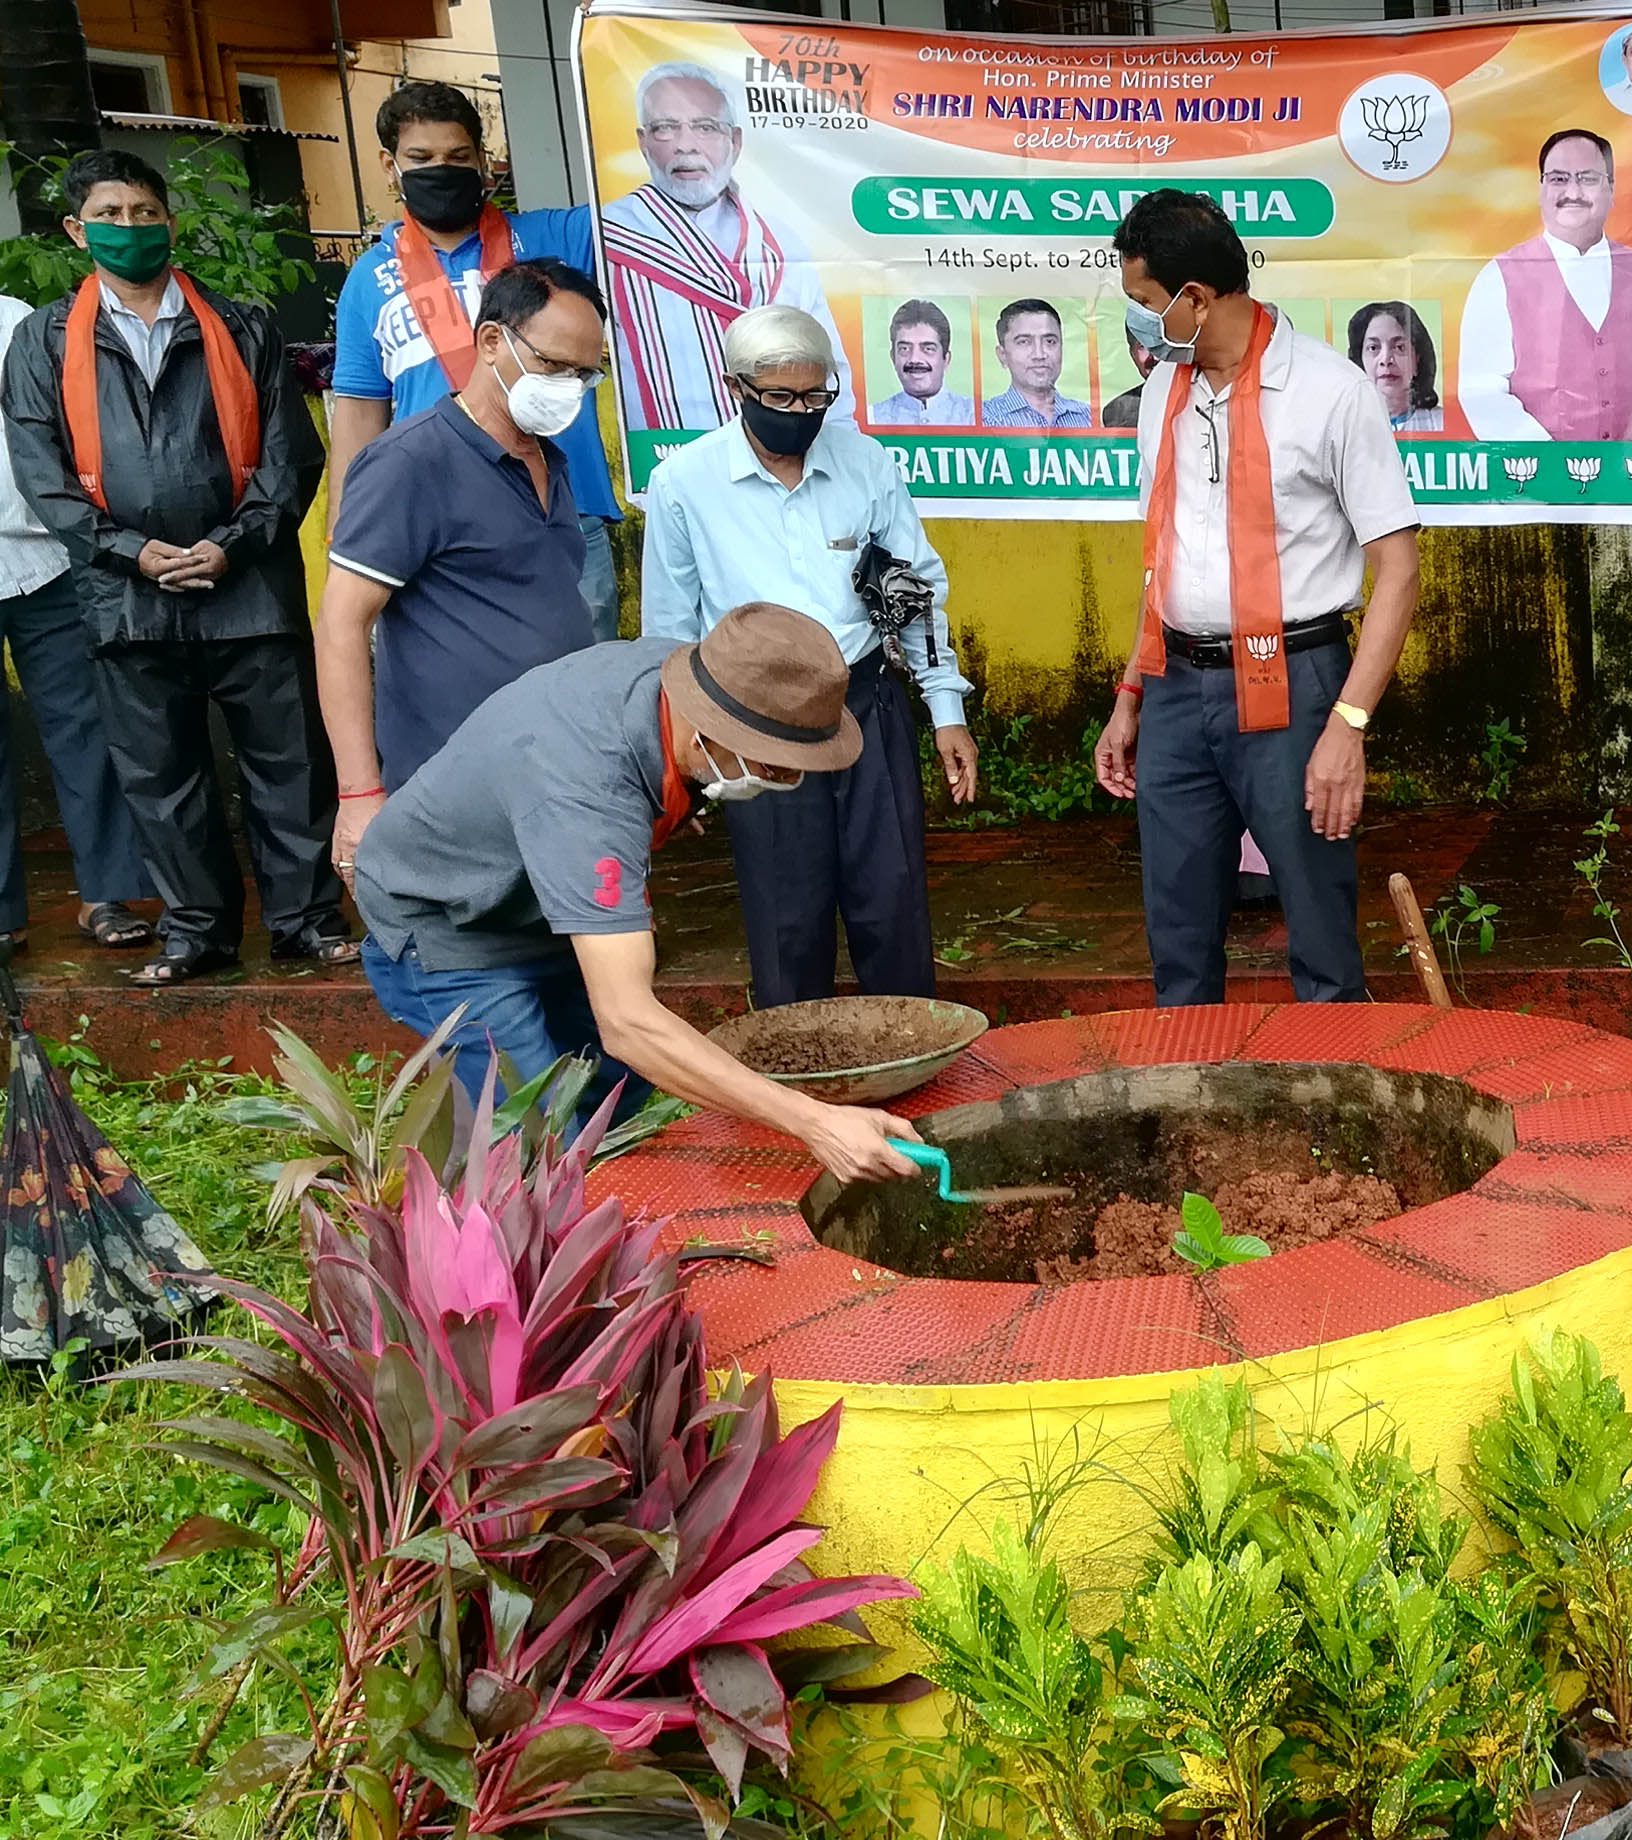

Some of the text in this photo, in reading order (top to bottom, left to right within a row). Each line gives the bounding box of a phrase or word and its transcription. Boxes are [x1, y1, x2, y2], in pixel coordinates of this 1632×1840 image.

[779, 35, 840, 57] 70th
[918, 46, 1281, 72] on occasion of birthday of
[746, 57, 871, 86] HAPPY
[983, 68, 1215, 89] Hon. Prime Minister
[746, 86, 868, 114] BIRTHDAY
[892, 92, 1302, 123] SHRI NARENDRA MODI JI
[749, 116, 868, 130] 17-09-2020
[1013, 127, 1178, 156] celebrating
[887, 188, 1034, 221] SEWA
[925, 248, 974, 268] 14th
[983, 249, 1038, 270] Sept.
[1048, 250, 1070, 268] to
[373, 258, 409, 296] 53
[885, 446, 1013, 484] RATIYA
[1402, 452, 1488, 491] ALIM
[594, 856, 622, 908] 3
